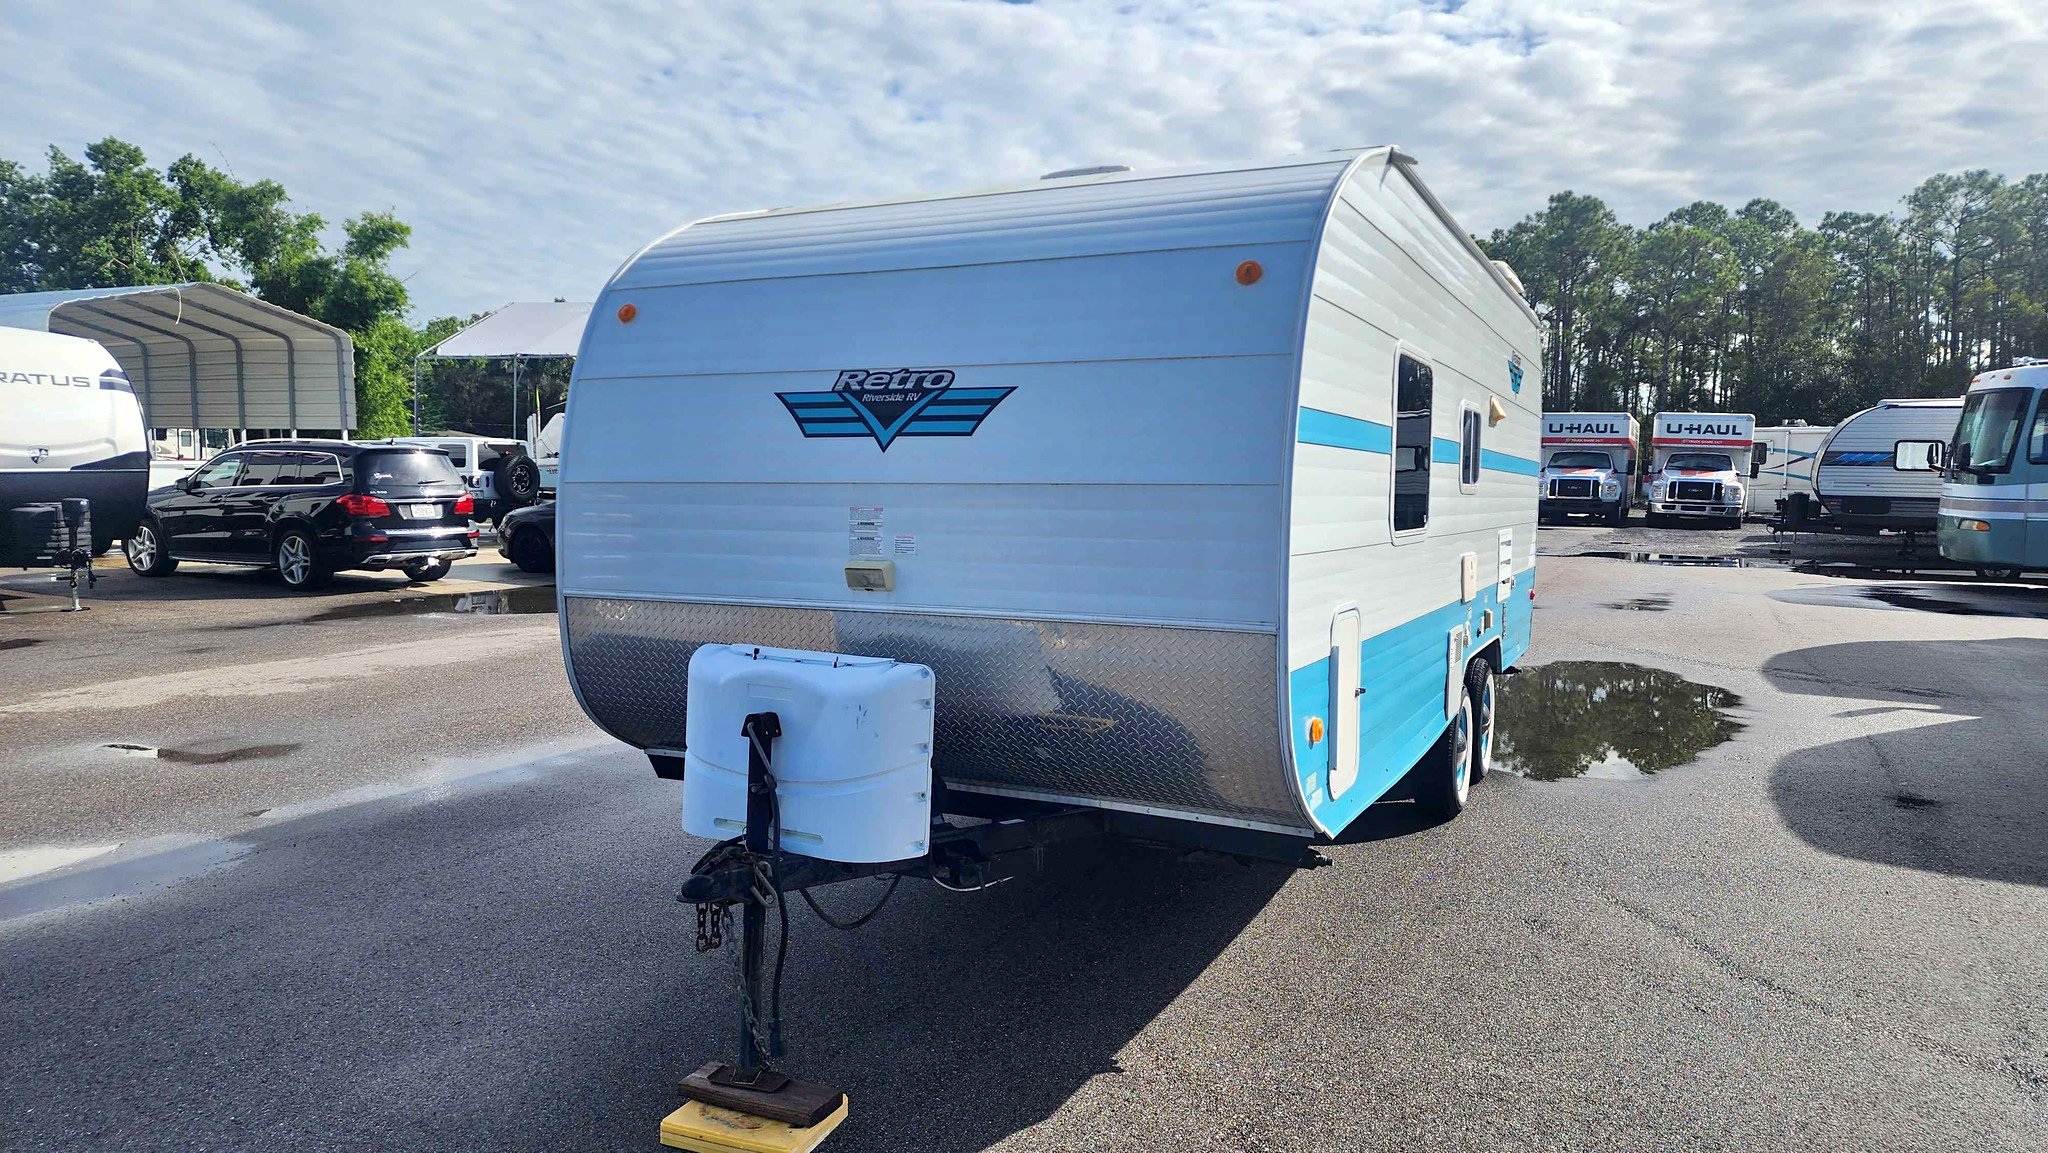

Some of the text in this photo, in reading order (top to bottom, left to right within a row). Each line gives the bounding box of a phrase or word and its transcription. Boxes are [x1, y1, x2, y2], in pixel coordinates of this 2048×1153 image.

[833, 369, 953, 391] Retro
[862, 392, 922, 402] Riverside RV
[1549, 423, 1620, 434] U-HAUL
[1666, 423, 1742, 435] U-HAUL
